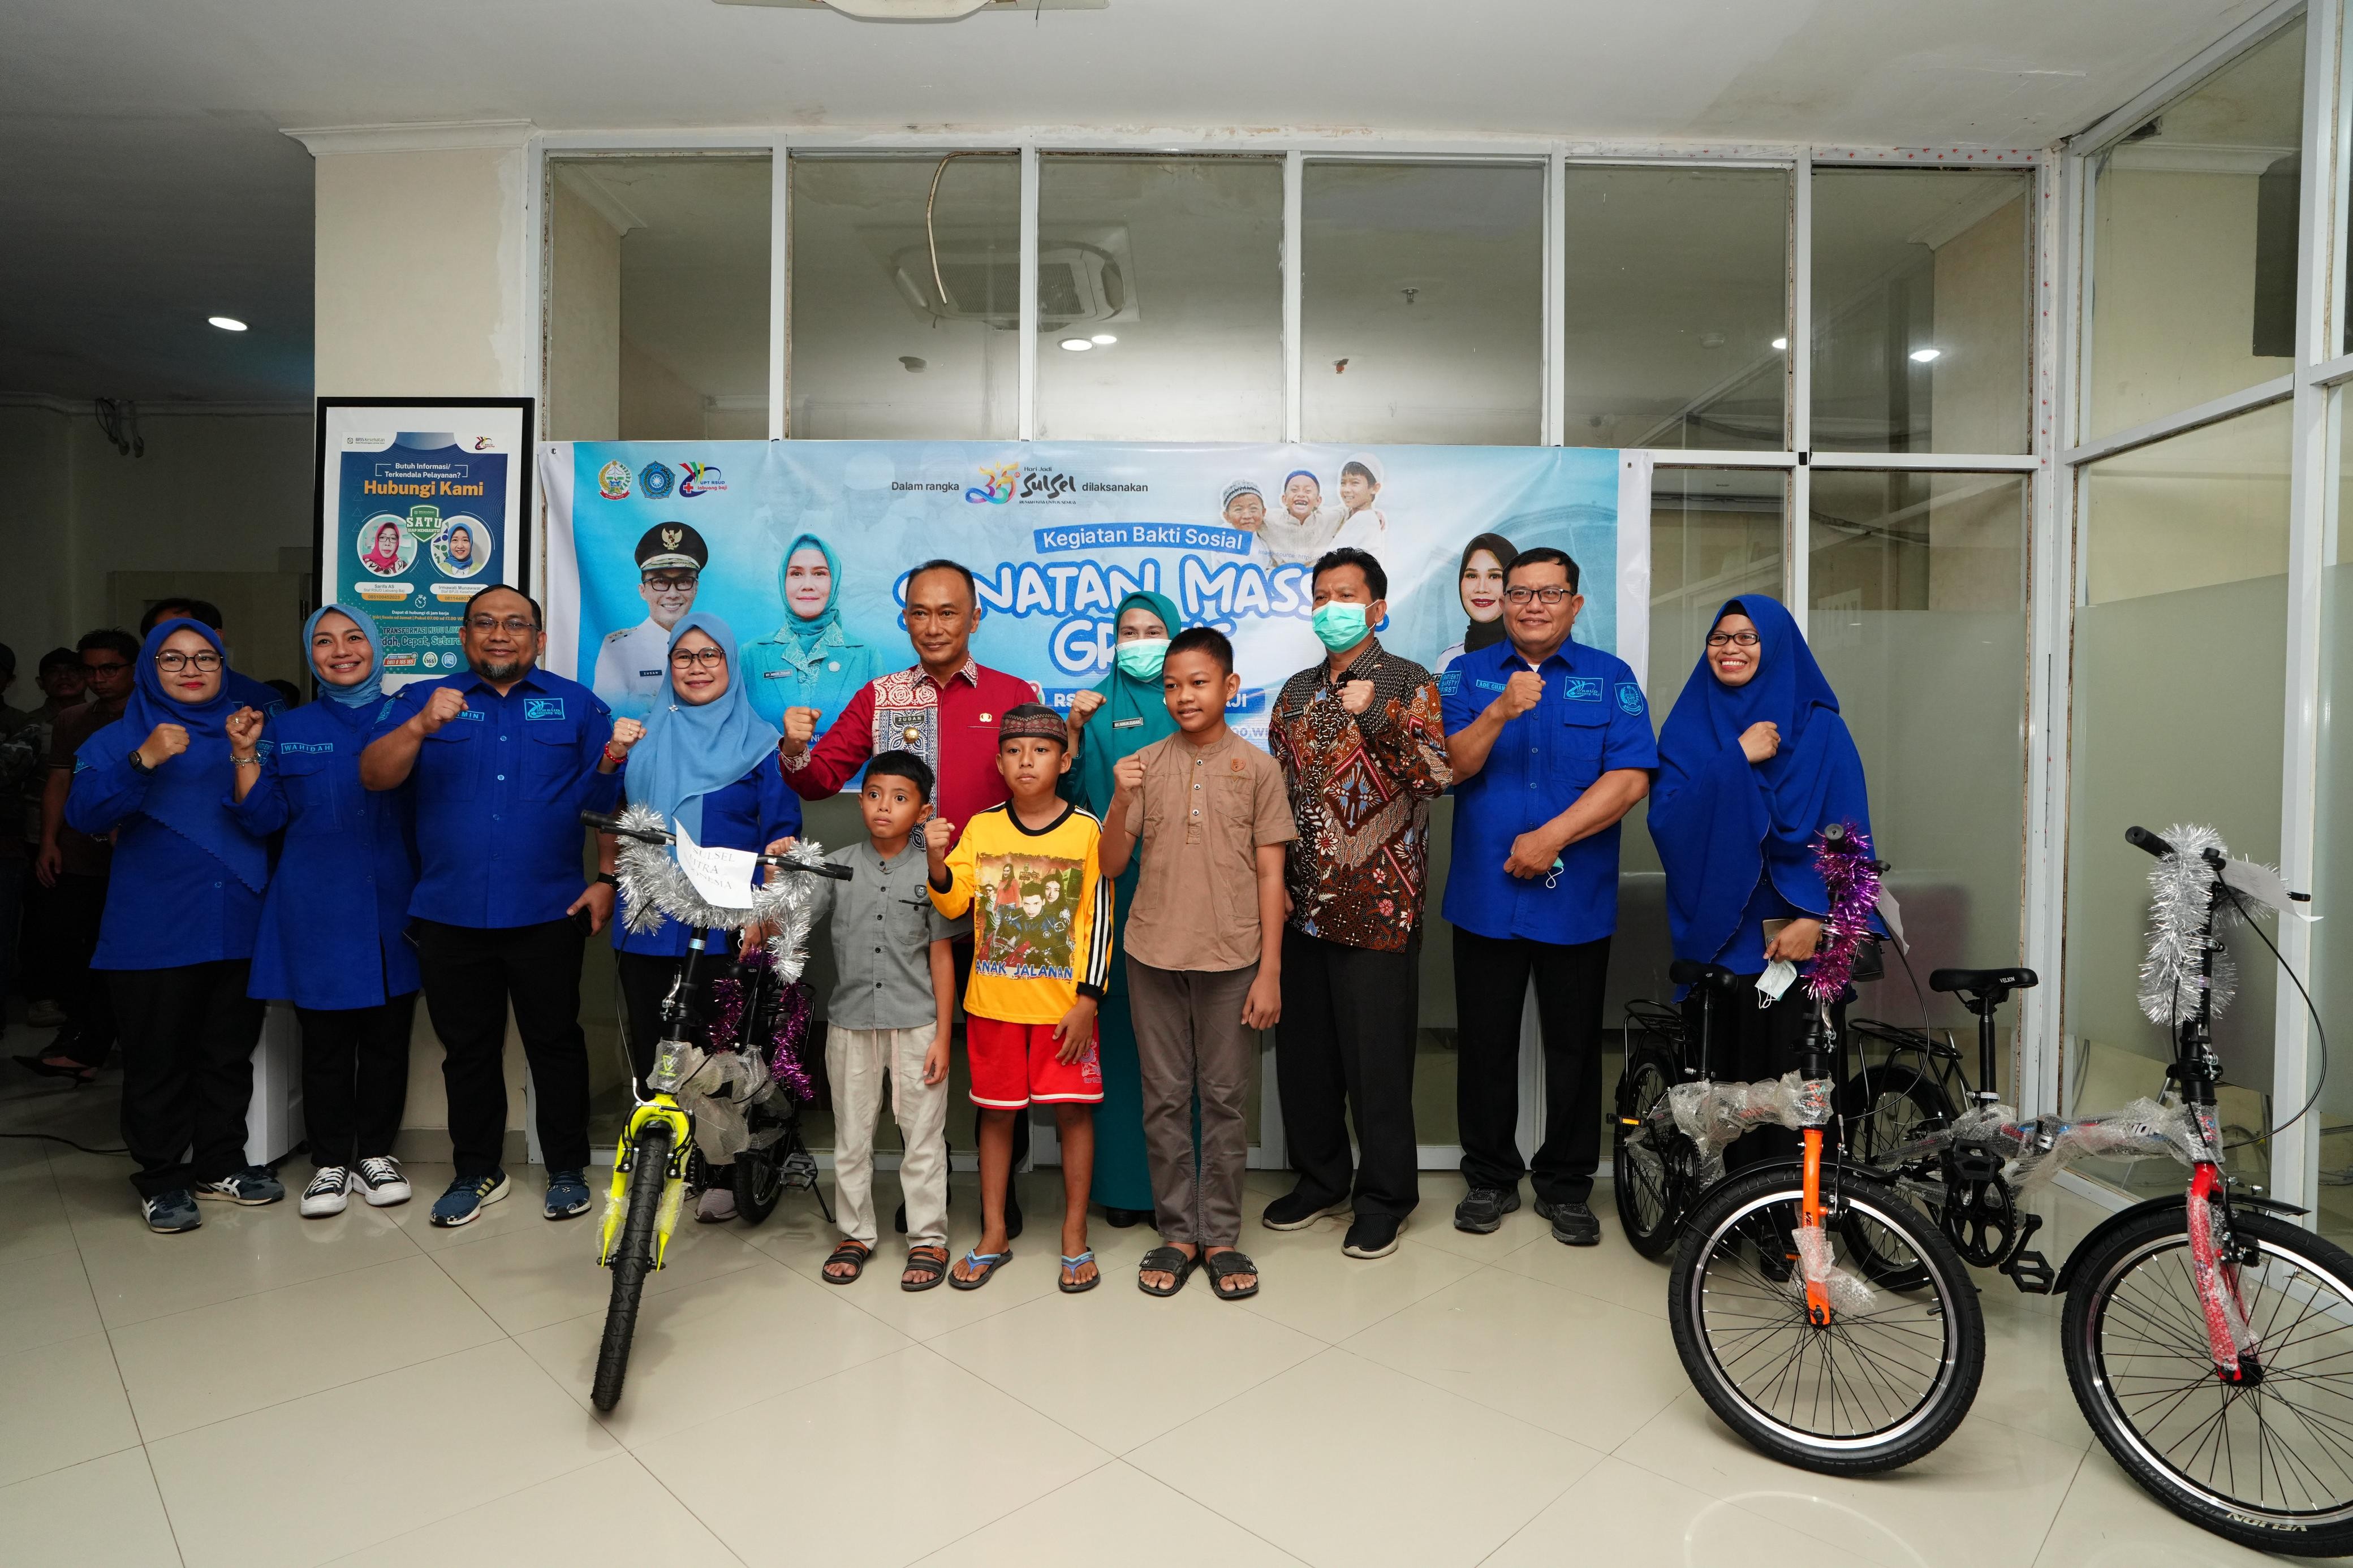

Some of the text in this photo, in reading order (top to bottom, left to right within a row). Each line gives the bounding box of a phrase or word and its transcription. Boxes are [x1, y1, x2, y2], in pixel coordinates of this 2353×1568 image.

[364, 480, 484, 498] Hubungi Kami
[891, 482, 959, 493] Dalam rangka
[1082, 482, 1148, 493] dilaksanakan
[406, 517, 443, 528] SATU
[1043, 526, 1243, 550] Kegiatan Bakti Sosial
[401, 636, 430, 649] Cepat,
[284, 744, 330, 752] WAHIDAH
[692, 848, 735, 862] SULSEL
[976, 959, 1073, 980] ANAK JALANAN
[2226, 1512, 2308, 1532] VELION
